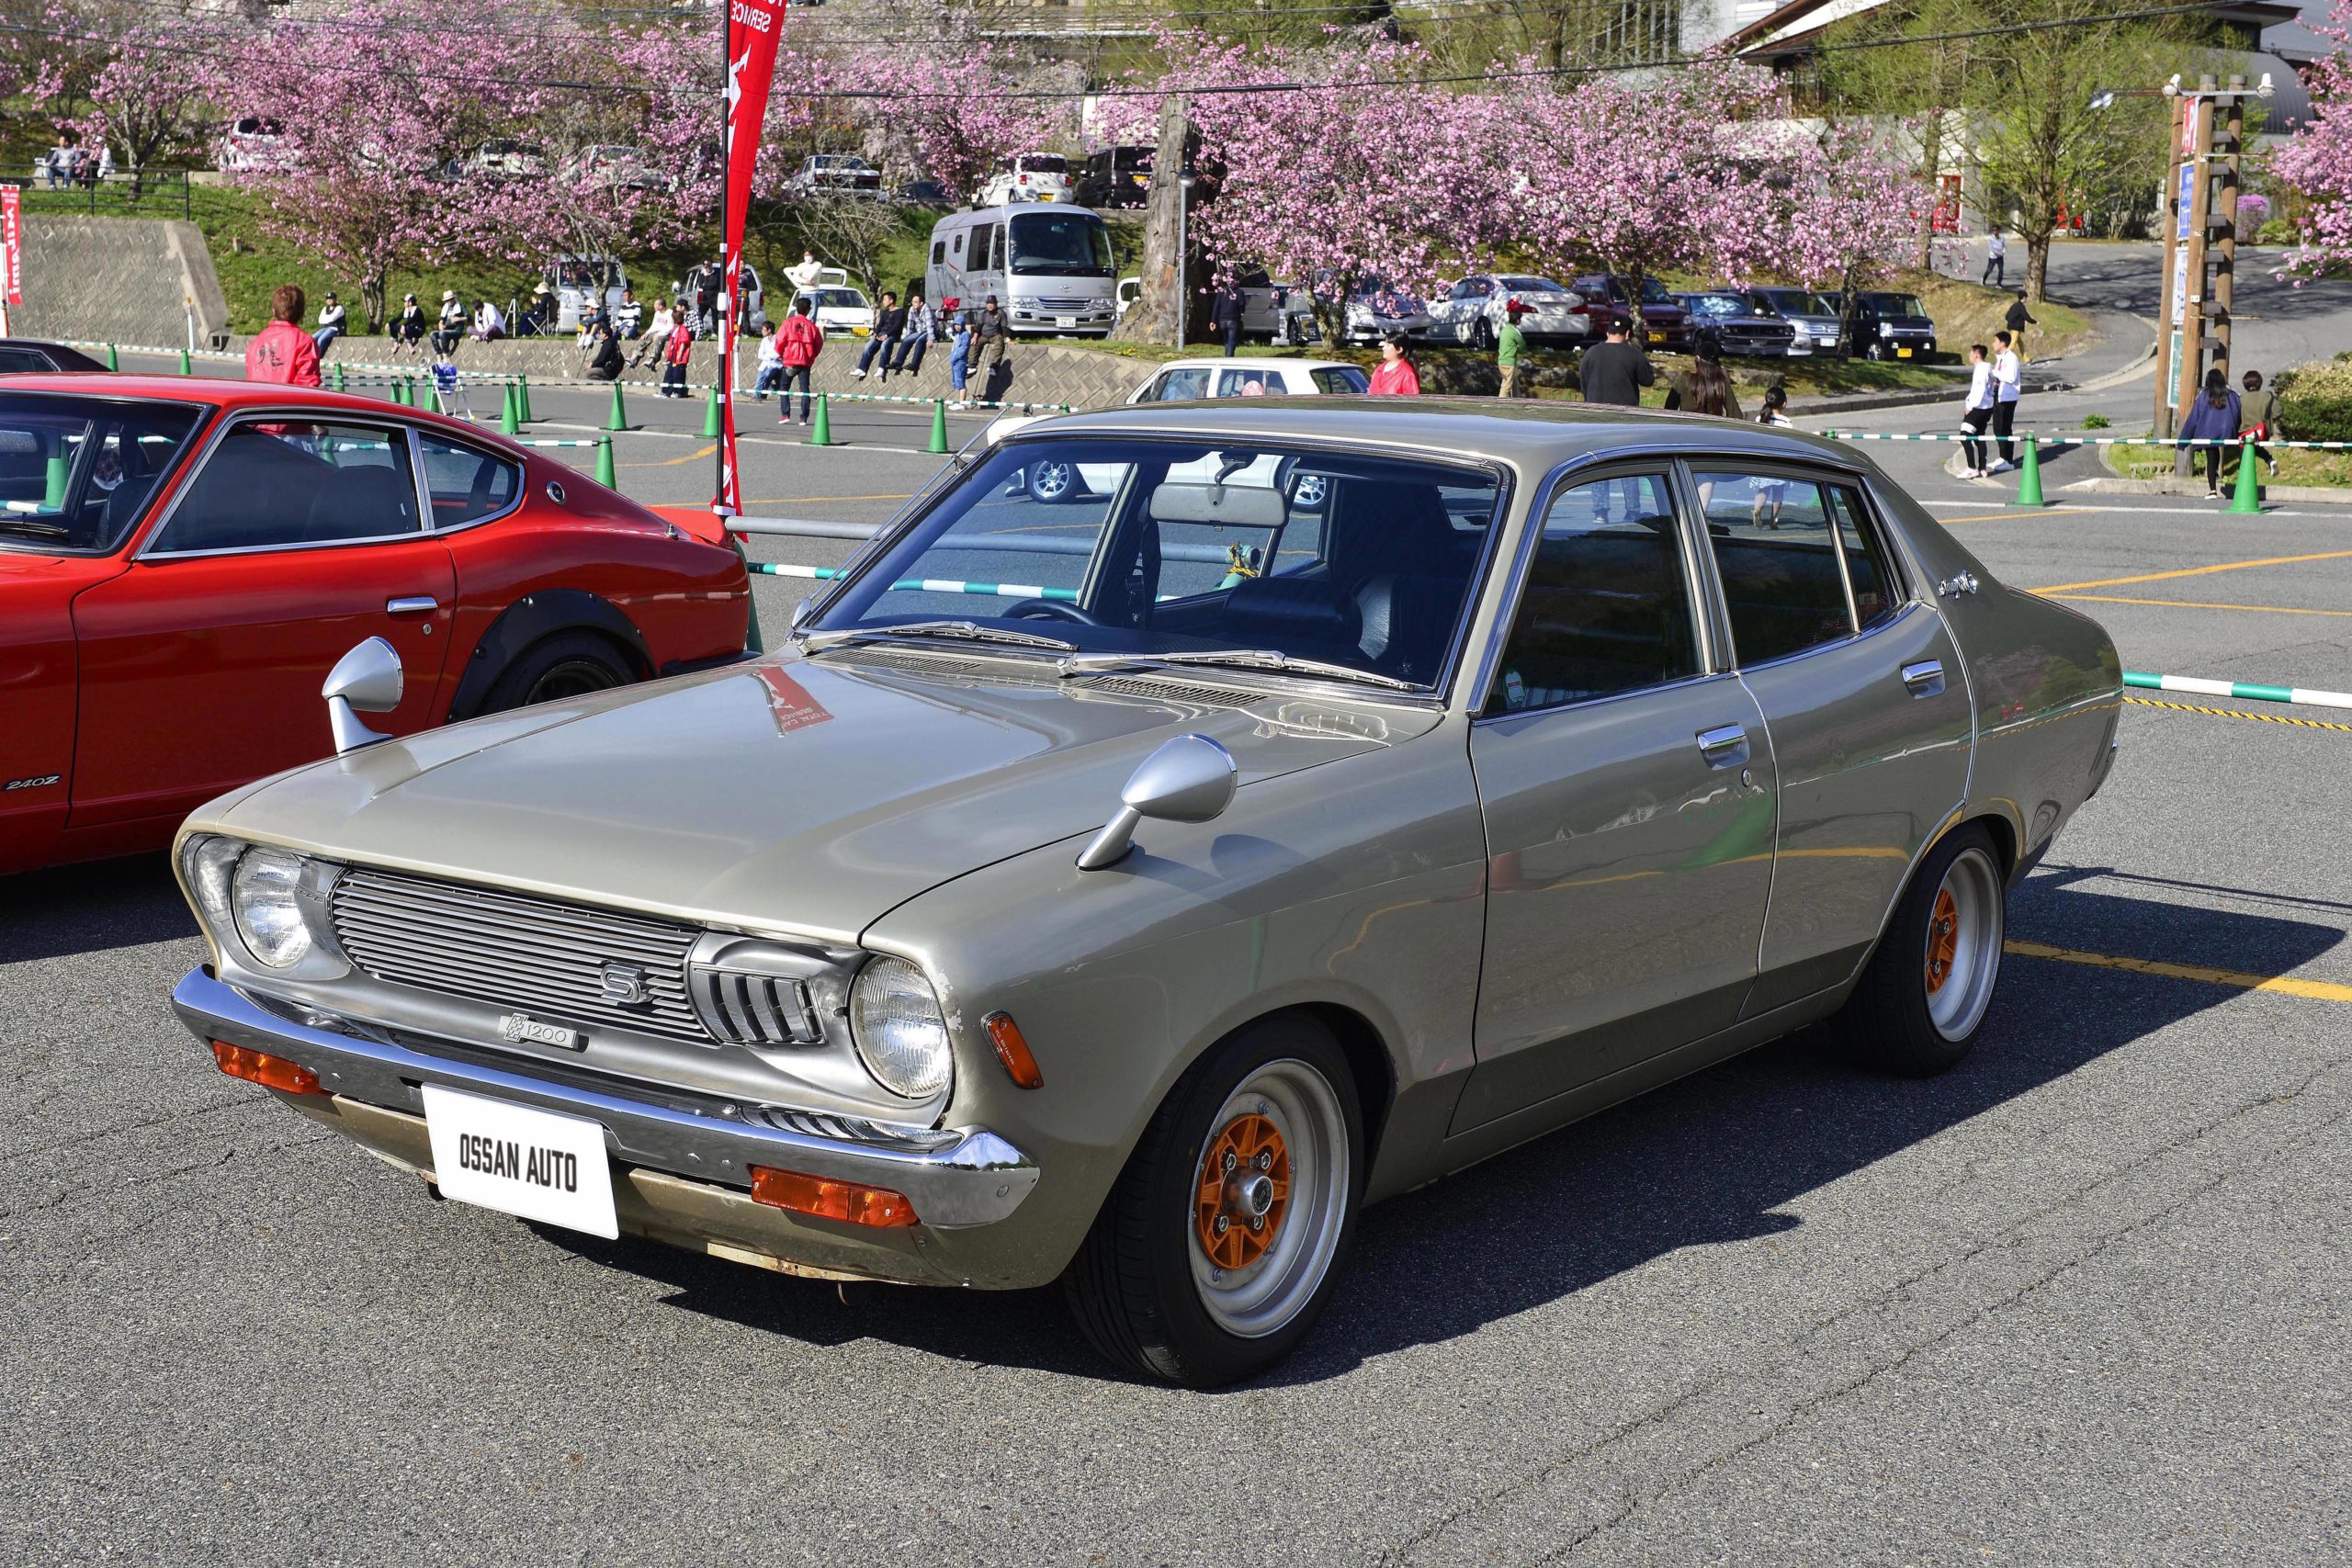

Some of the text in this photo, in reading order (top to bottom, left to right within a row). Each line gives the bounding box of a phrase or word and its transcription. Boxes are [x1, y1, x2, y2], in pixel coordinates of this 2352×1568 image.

[6, 775, 60, 790] 240Z
[600, 964, 642, 1004] S
[526, 1024, 567, 1043] 1200
[460, 1133, 577, 1193] OSSAN AUTO
